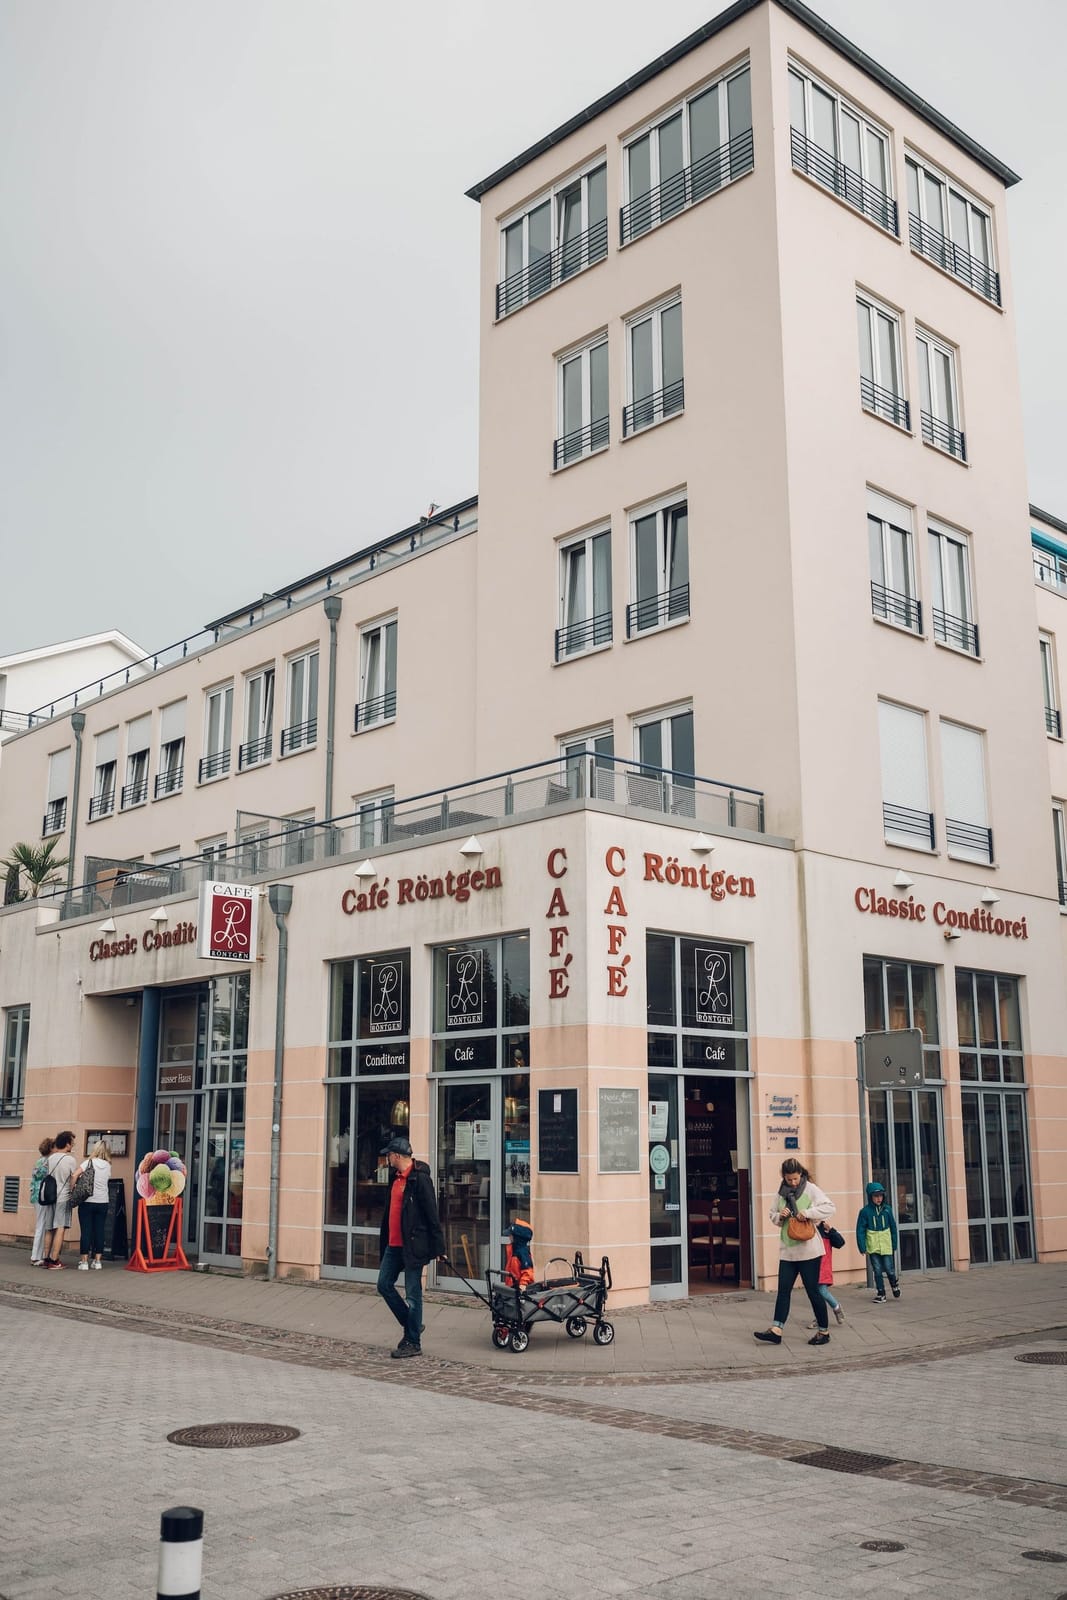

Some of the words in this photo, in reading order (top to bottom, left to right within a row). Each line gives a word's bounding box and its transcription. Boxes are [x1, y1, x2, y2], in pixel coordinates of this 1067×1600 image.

[212, 885, 253, 898] CAFÉ
[341, 877, 390, 915] Café
[397, 866, 503, 905] Röntgen
[643, 852, 757, 902] Röntgen
[546, 848, 574, 999] CAFÉ
[604, 846, 632, 997] CAFÉ
[854, 887, 926, 922] Classic
[932, 901, 1030, 940] Conditorei
[89, 933, 138, 962] Classic
[142, 921, 198, 952] Condit
[365, 1053, 406, 1067] Conditorei
[454, 1047, 474, 1061] Café
[705, 1046, 726, 1061] Café
